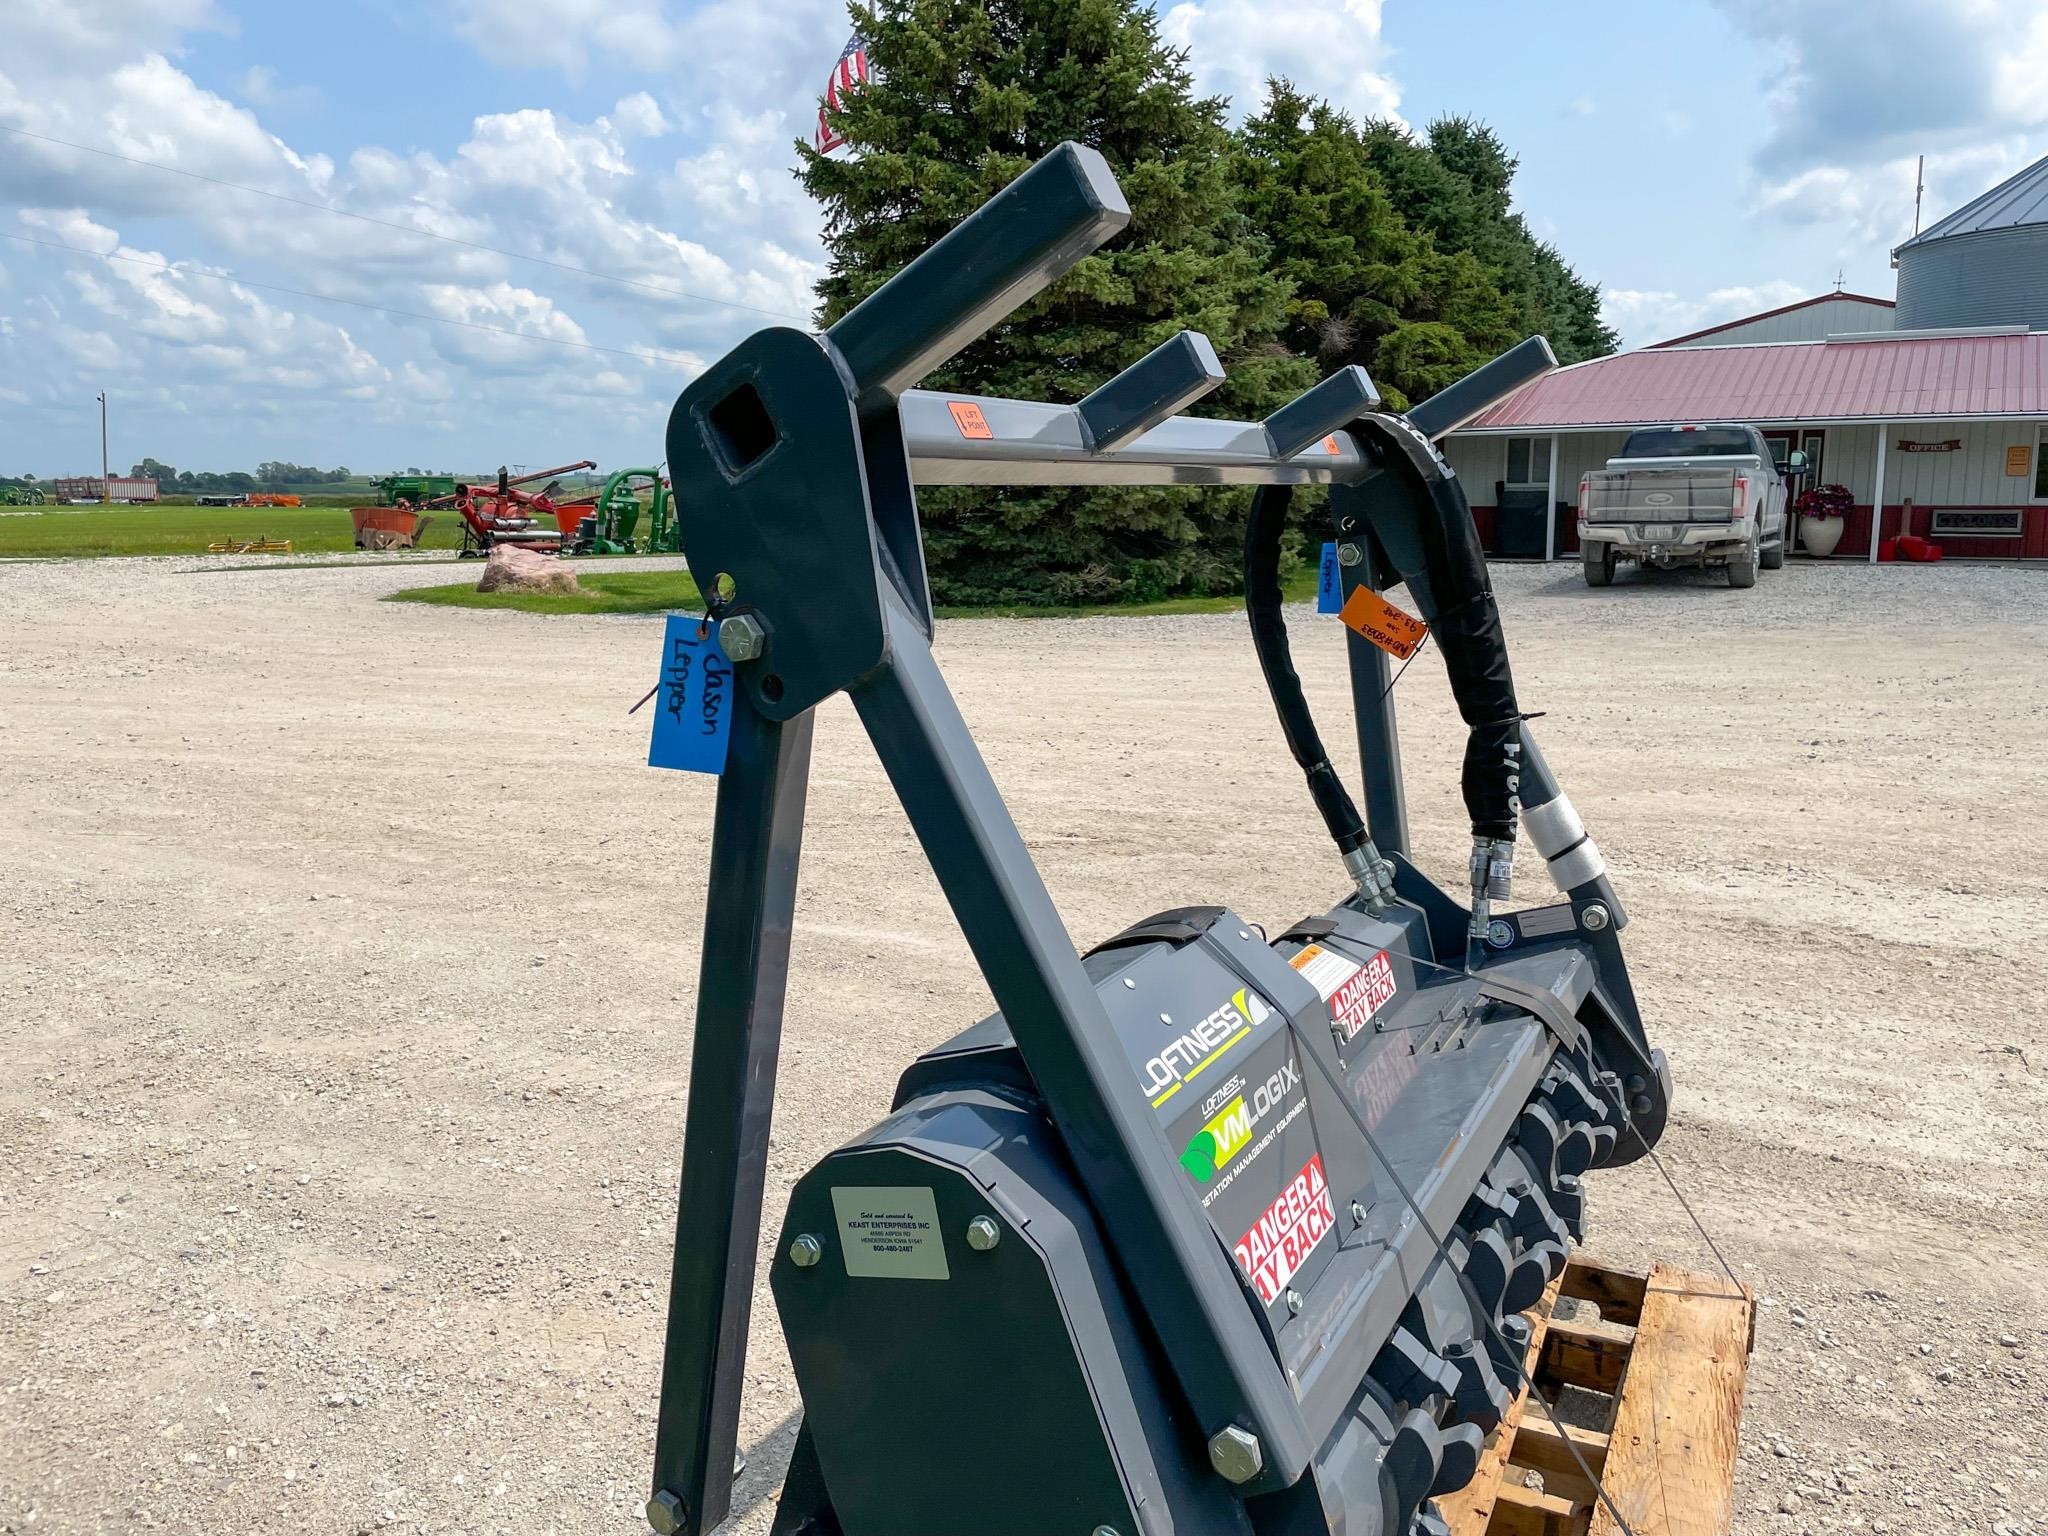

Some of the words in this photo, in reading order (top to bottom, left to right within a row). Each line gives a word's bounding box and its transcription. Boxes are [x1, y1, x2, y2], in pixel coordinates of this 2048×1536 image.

[964, 410, 979, 419] LIFT
[967, 421, 986, 431] POINT
[665, 638, 699, 727] Lepper
[702, 653, 731, 735] Jason
[1340, 958, 1384, 1012] DANGER
[1345, 999, 1366, 1035] TAY
[1367, 976, 1396, 1013] BACK
[1140, 1002, 1243, 1098] LOFTNESS
[1201, 1074, 1240, 1117] LOFTNESS
[1233, 1128, 1276, 1178] MANAGEMENT
[1275, 1096, 1308, 1134] EQUIPMENT
[848, 1221, 870, 1229] KEAST
[871, 1221, 917, 1229] ENTERPRISES
[1283, 1192, 1335, 1274] BACK
